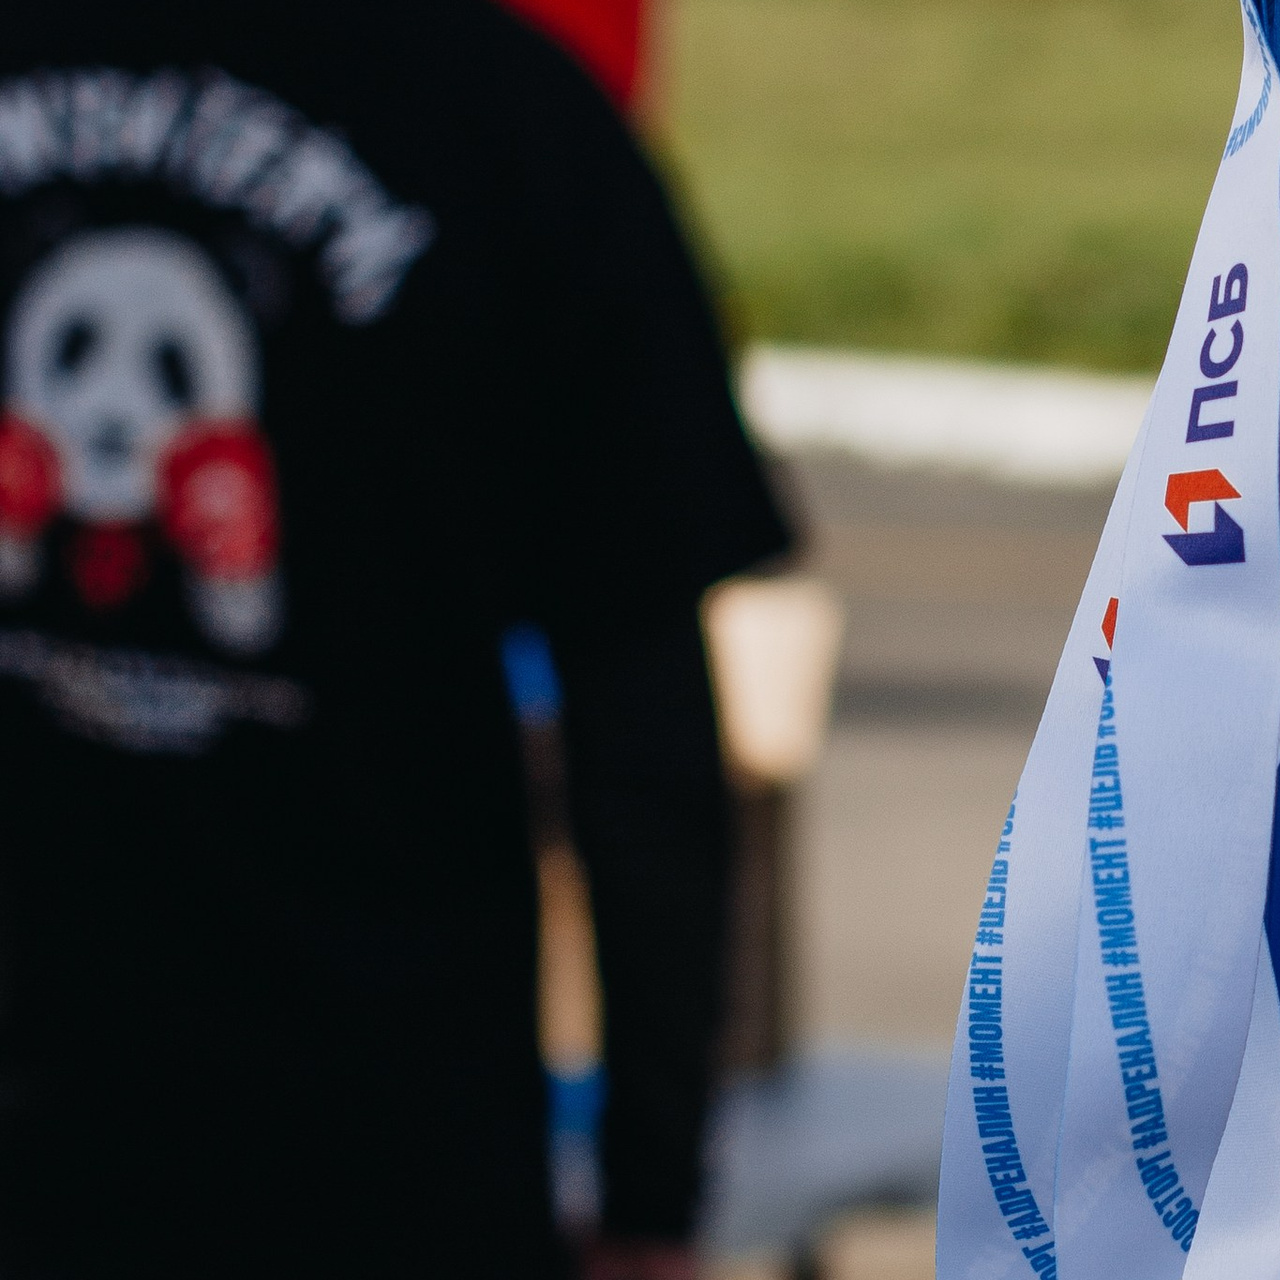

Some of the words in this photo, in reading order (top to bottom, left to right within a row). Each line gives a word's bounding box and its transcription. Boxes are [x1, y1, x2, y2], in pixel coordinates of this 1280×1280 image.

[1184, 260, 1250, 445] ПСБ
[1090, 838, 1140, 967] #МОМЕНТ
[968, 951, 1005, 1081] #МОМЕНТ
[1105, 971, 1170, 1150] #АДРЕНАЛИН
[972, 1086, 1051, 1240] #АДРЕНАЛИН
